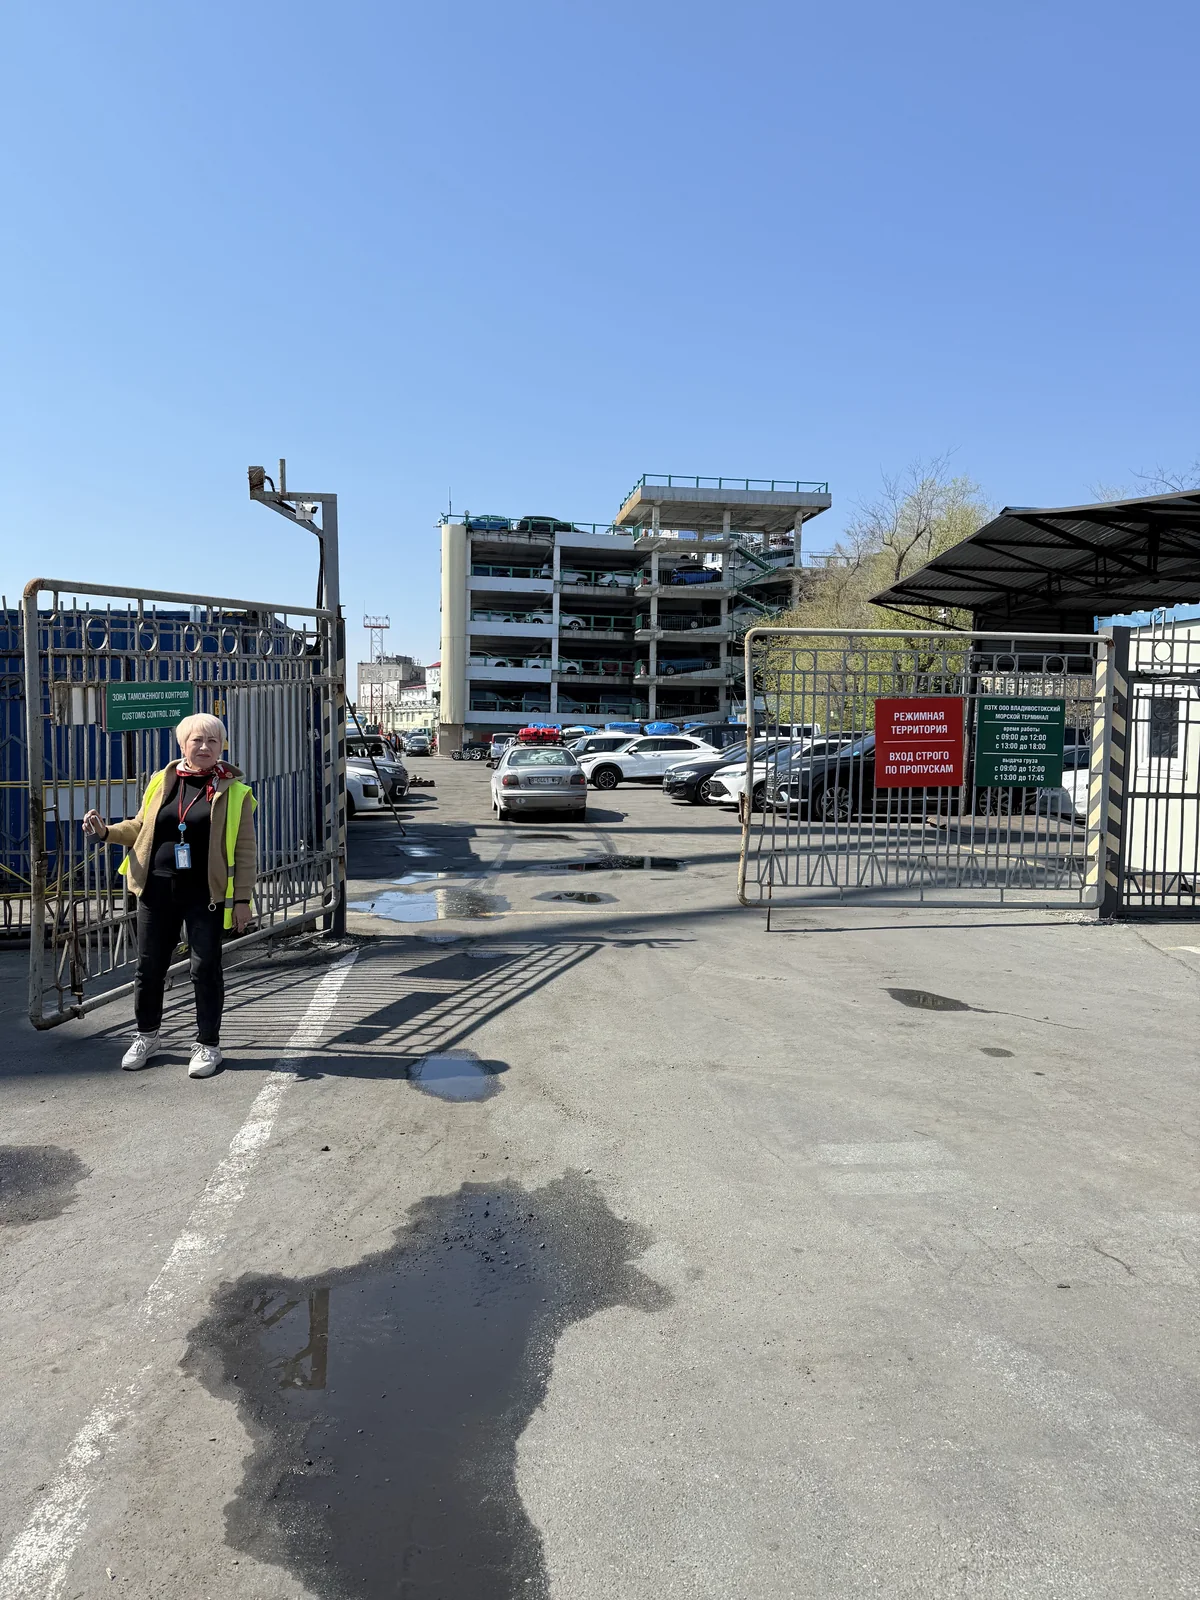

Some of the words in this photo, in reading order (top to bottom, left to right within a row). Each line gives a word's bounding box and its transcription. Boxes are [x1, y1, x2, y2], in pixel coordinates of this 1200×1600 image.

[128, 692, 164, 700] ТАМОЖЕННОГО
[122, 711, 145, 720] CUSTOMS
[147, 710, 168, 718] CONTROL
[894, 712, 944, 721] РЕЖИМНАЯ
[891, 725, 948, 734] ТЕРРИТОРИЯ
[889, 752, 913, 762] ВХОД
[916, 751, 949, 760] СТРОГО
[885, 766, 897, 774] ПО
[900, 764, 953, 774] ПРОПУСКАМ
